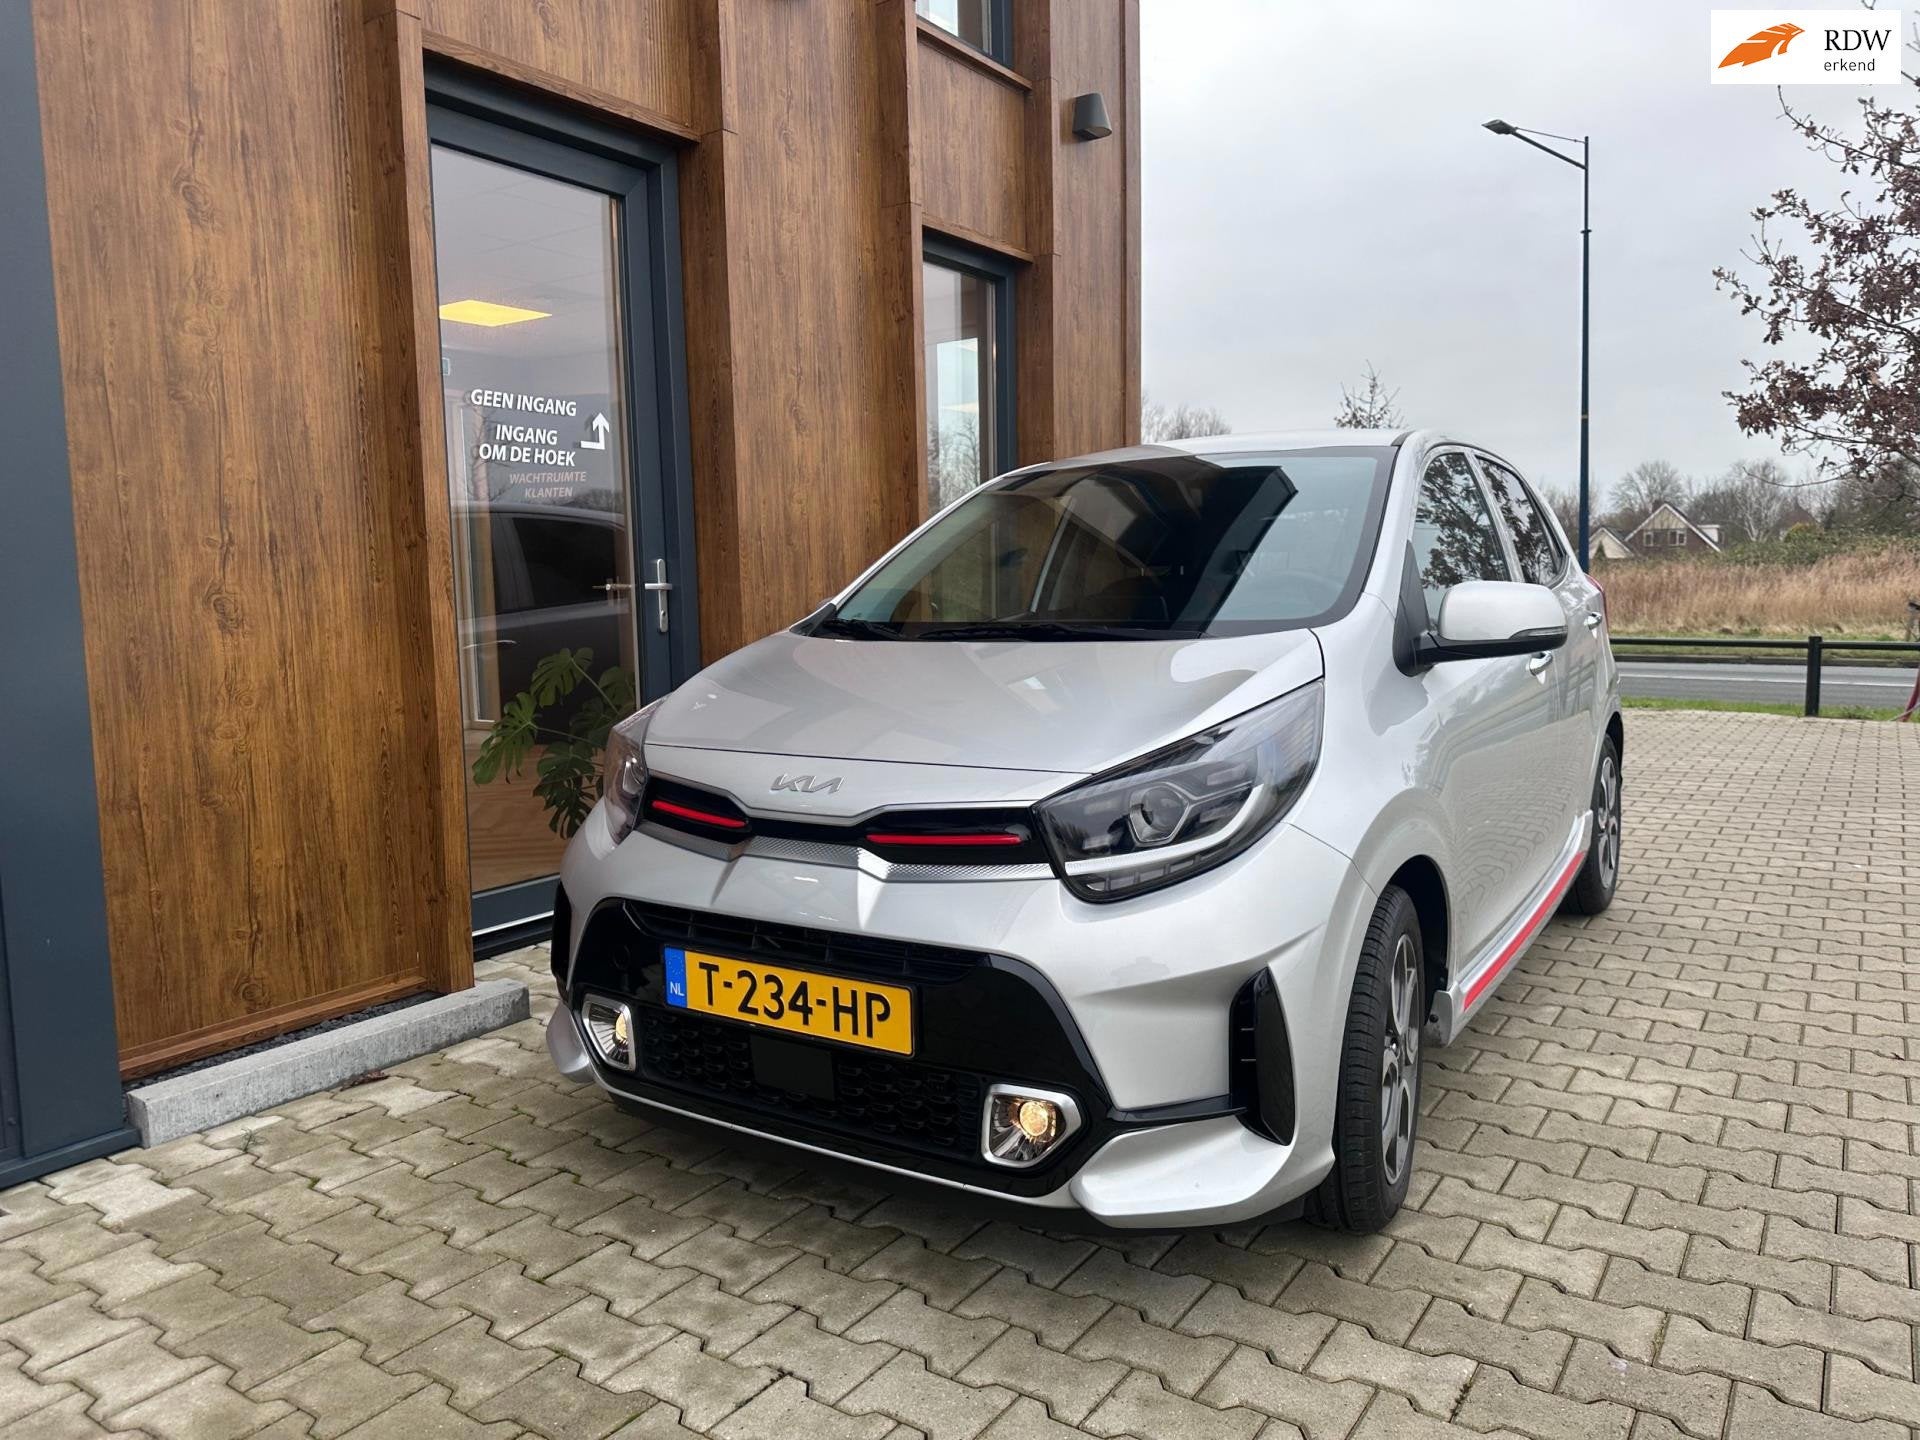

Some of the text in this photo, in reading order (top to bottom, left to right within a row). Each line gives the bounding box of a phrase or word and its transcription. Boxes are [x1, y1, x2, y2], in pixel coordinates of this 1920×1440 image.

[471, 388, 577, 417] GEEN INGANG
[495, 424, 558, 446] INGANG
[479, 443, 576, 467] OM DE HOEK
[509, 471, 587, 484] WACHTRUIMTE
[524, 487, 573, 499] KLANTEN
[670, 981, 685, 996] NL
[698, 961, 891, 1039] T-234-HP
